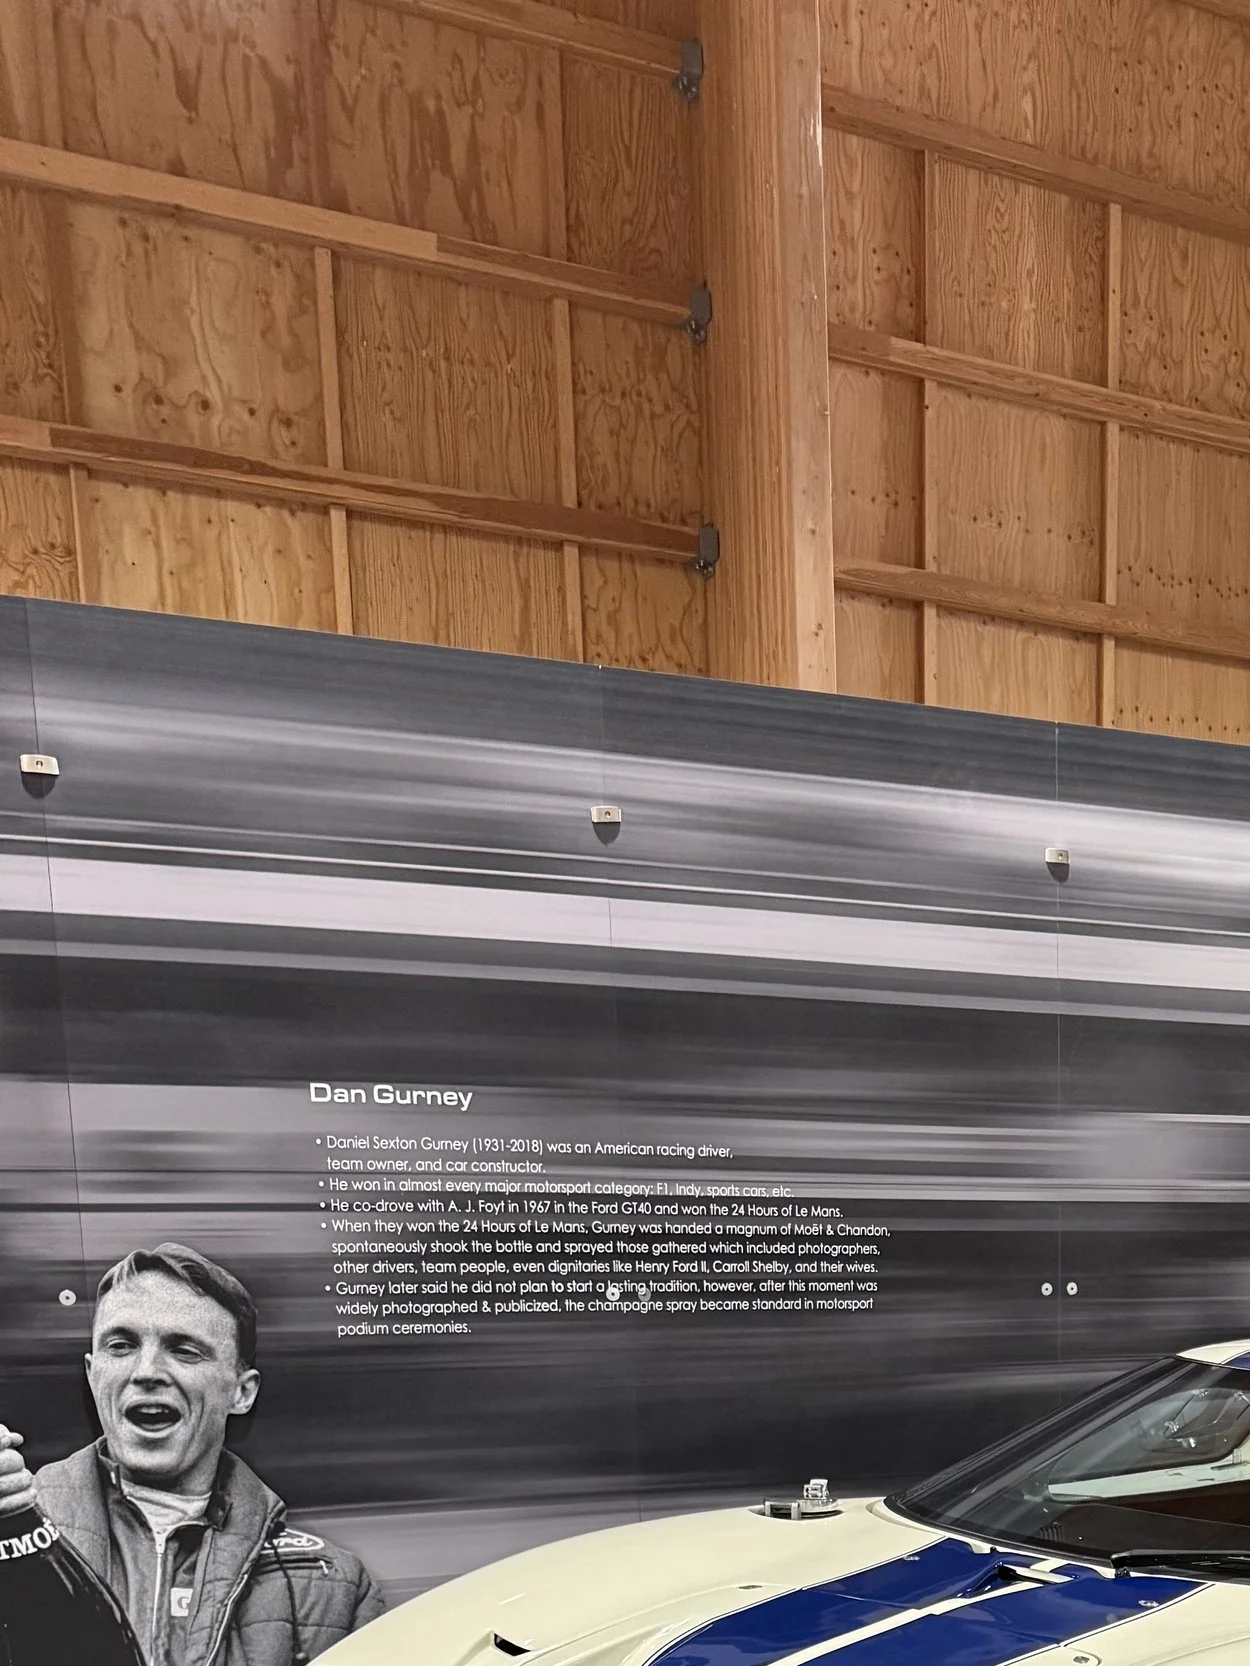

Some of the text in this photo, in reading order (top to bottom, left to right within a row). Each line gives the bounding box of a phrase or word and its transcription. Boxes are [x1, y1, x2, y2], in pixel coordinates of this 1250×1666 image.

[309, 1082, 473, 1111] Dan Gurney
[326, 1135, 733, 1159] Daniel Sexton Gurney (1931-2018) was an American racing driver,
[326, 1157, 548, 1173] team owner, and car constructor.
[329, 1177, 795, 1198] He won in almost every major motorsport category: F1, Indy, sports cars, etc.
[330, 1198, 843, 1218] He co-drove with A. J. Foyt in 1967 in the Ford GT40 and won the 24 Hours of Le Mans.
[331, 1219, 371, 1232] When
[373, 1218, 403, 1235] they
[405, 1221, 435, 1233] won
[437, 1219, 460, 1233] the
[462, 1219, 478, 1233] 24
[480, 1219, 516, 1233] Hours
[518, 1219, 532, 1233] of
[534, 1219, 549, 1233] Le
[551, 1220, 589, 1234] Mans,
[591, 1220, 636, 1236] Gurney
[638, 1223, 664, 1234] was
[664, 1221, 712, 1235] handed
[714, 1224, 723, 1235] a
[725, 1224, 778, 1238] magnum
[779, 1222, 792, 1236] of
[825, 1223, 836, 1236] &
[836, 1223, 891, 1237] Chandon,
[331, 1239, 880, 1257] spontaneously shook the bottle and sprayed those gathered which included photographers,
[333, 1259, 879, 1276] other drivers, team people, even dignitaries like Henry Ford II, Carroll Shelby, and their wives.
[335, 1279, 878, 1297] Gurney later said he did not plan to start a lasting tradition, however, after this moment was
[335, 1297, 874, 1317] widely photographed & publicized, the champagne spray became standard in motorsport
[337, 1320, 472, 1338] podium ceremonies.
[264, 1532, 313, 1547] ord
